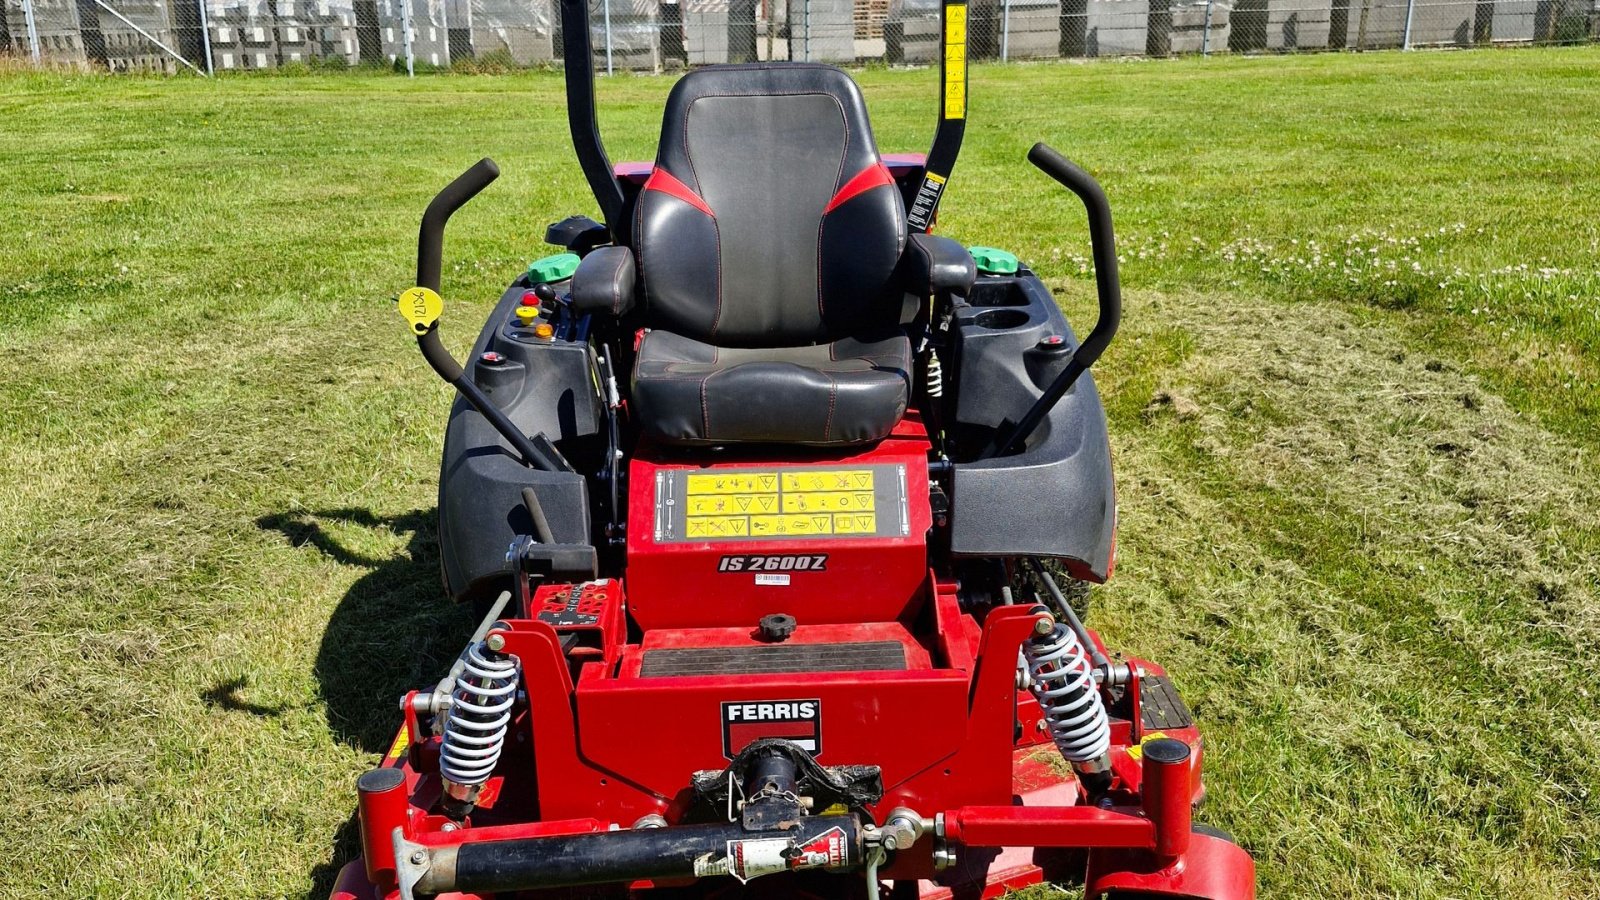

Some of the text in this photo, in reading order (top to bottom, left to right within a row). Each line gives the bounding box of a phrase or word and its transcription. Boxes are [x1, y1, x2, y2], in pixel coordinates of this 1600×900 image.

[719, 555, 827, 571] IS 2600Z
[728, 702, 815, 721] FERRIS
